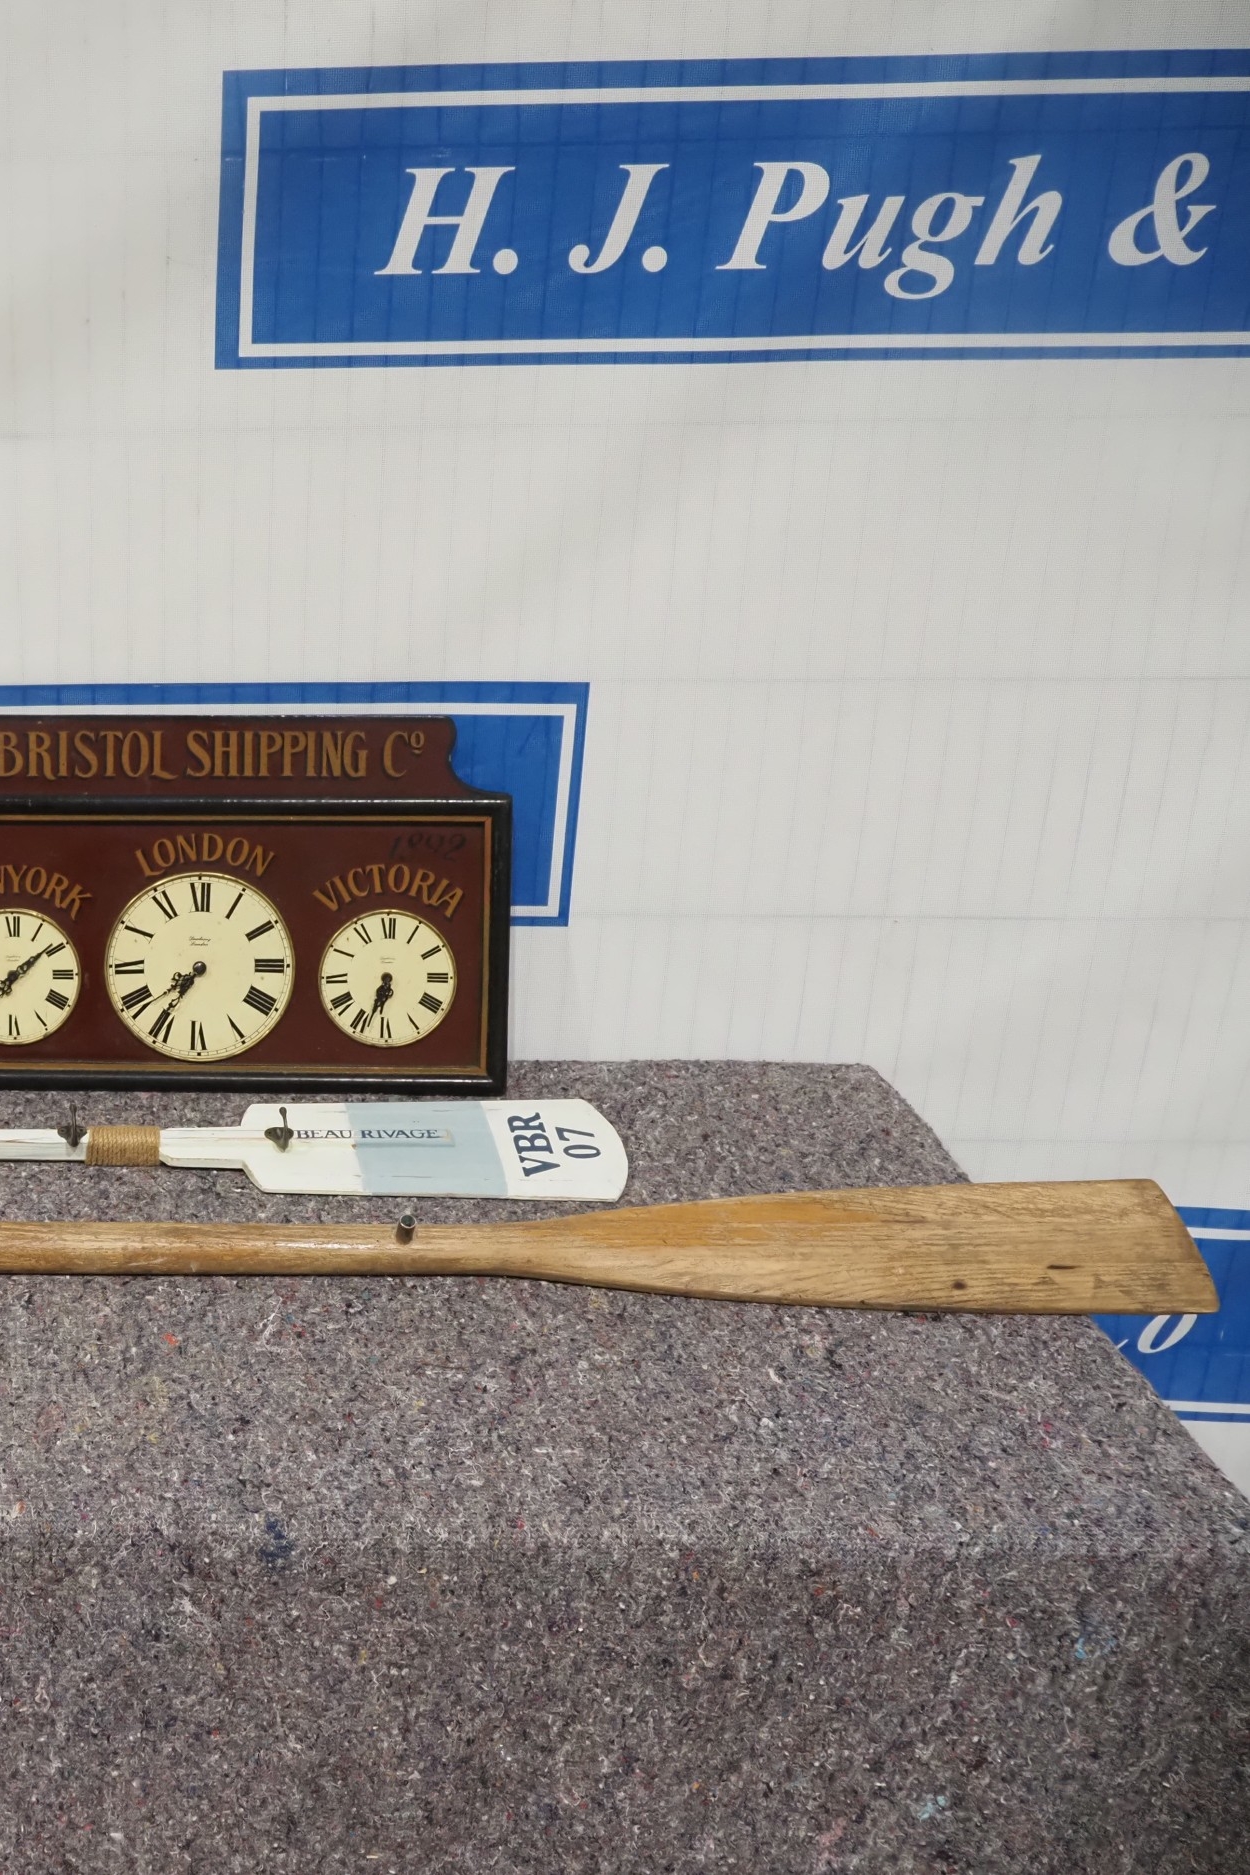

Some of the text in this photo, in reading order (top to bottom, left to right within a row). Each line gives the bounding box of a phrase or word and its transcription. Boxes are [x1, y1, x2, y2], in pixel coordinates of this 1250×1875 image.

[373, 151, 1219, 302] H. J. Pugh &
[185, 729, 370, 779] SHIPPING
[134, 832, 276, 878] LONDON
[312, 863, 465, 919] VICTORIA
[297, 1128, 441, 1140] BEAU RIVAGE
[507, 1112, 561, 1177] VBR
[555, 1126, 601, 1159] 07
